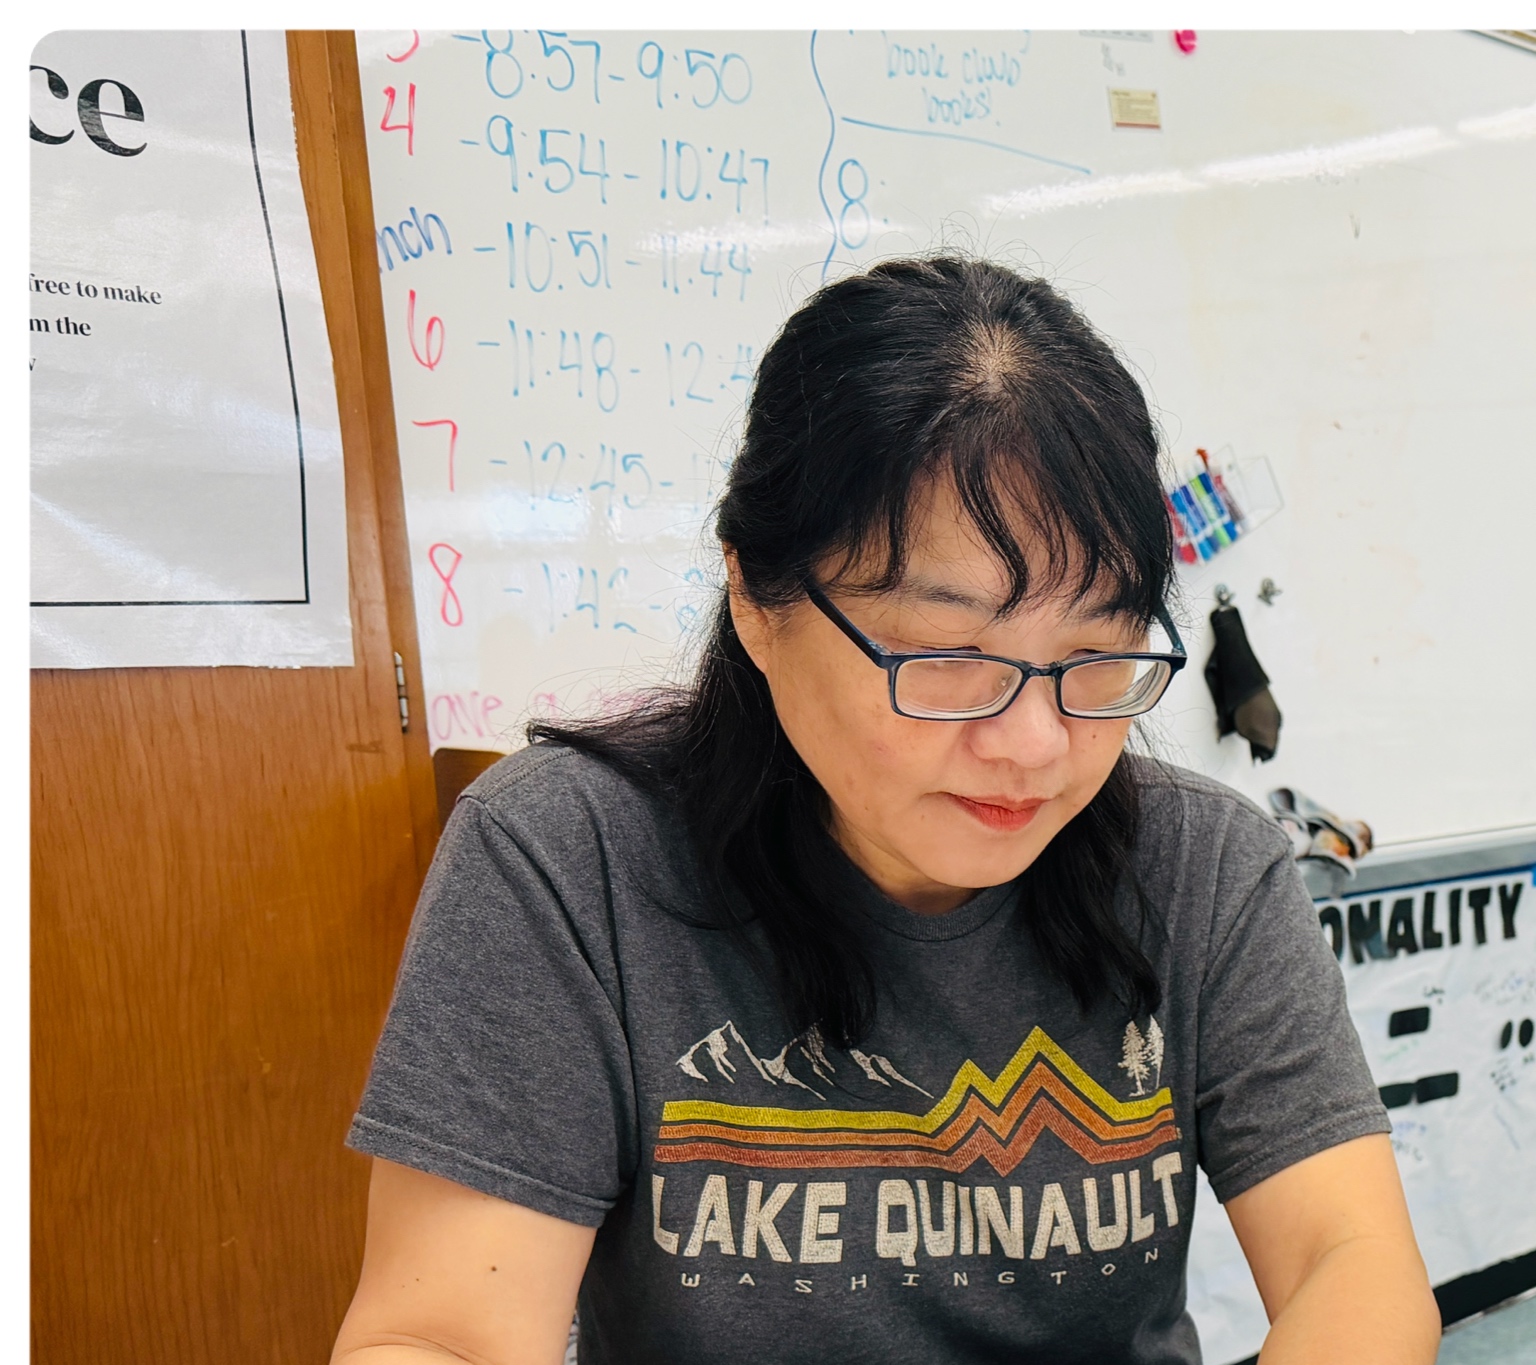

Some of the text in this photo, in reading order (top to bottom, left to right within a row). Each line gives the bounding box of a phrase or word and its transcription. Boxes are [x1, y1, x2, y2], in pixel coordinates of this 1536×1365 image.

[380, 82, 417, 156] 4
[375, 206, 453, 274] nch
[56, 317, 92, 337] the
[76, 280, 99, 299] to
[103, 285, 163, 305] make
[407, 289, 445, 371] 6
[411, 418, 458, 493] 7
[428, 542, 463, 627] 8
[430, 690, 502, 742] ave
[1320, 882, 1524, 965] ONALITY
[652, 1150, 1183, 1267] LAKE QUINAULT
[680, 1246, 1159, 1295] WASHINGTON
